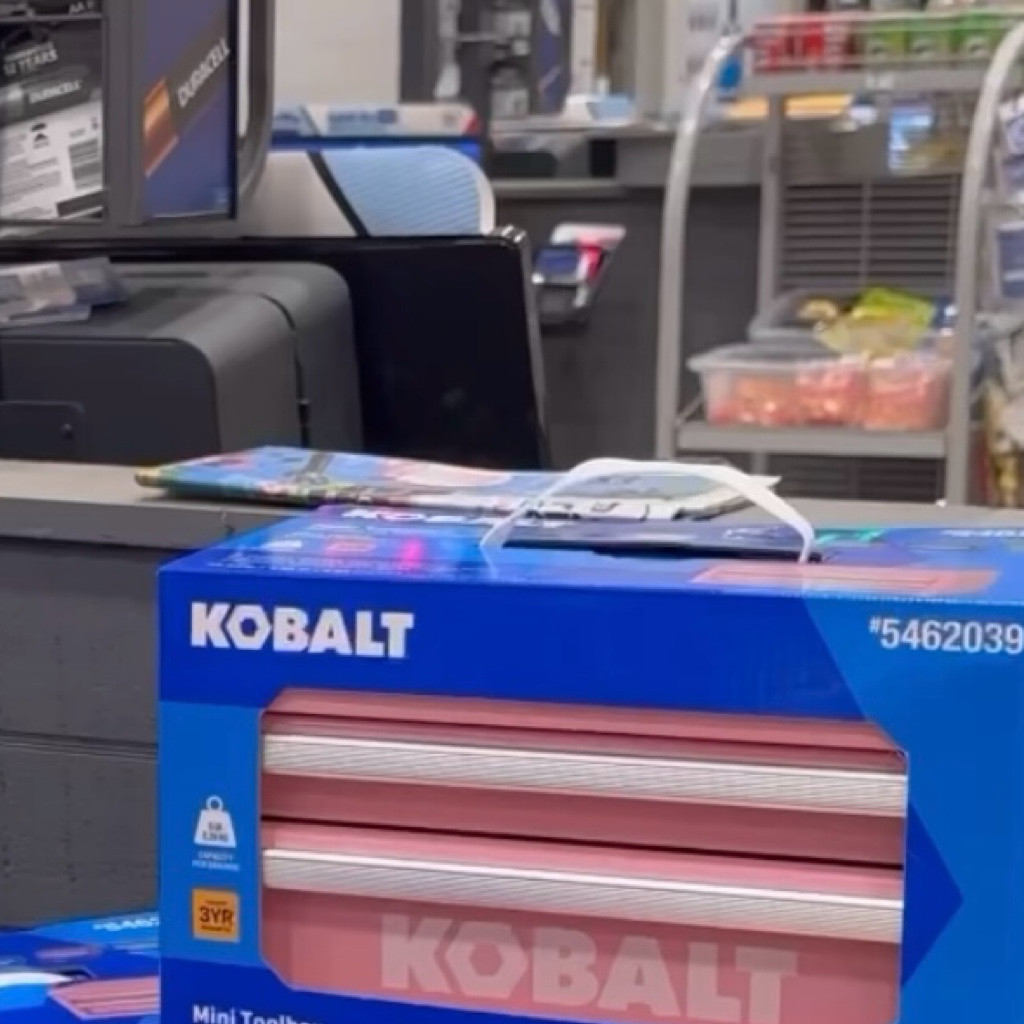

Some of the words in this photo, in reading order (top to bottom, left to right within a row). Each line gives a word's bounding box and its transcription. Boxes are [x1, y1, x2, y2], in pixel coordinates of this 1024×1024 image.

[178, 37, 231, 109] DURACELL
[189, 602, 415, 660] KOBALT
[868, 615, 1024, 655] #5462039
[199, 906, 234, 927] 3YR
